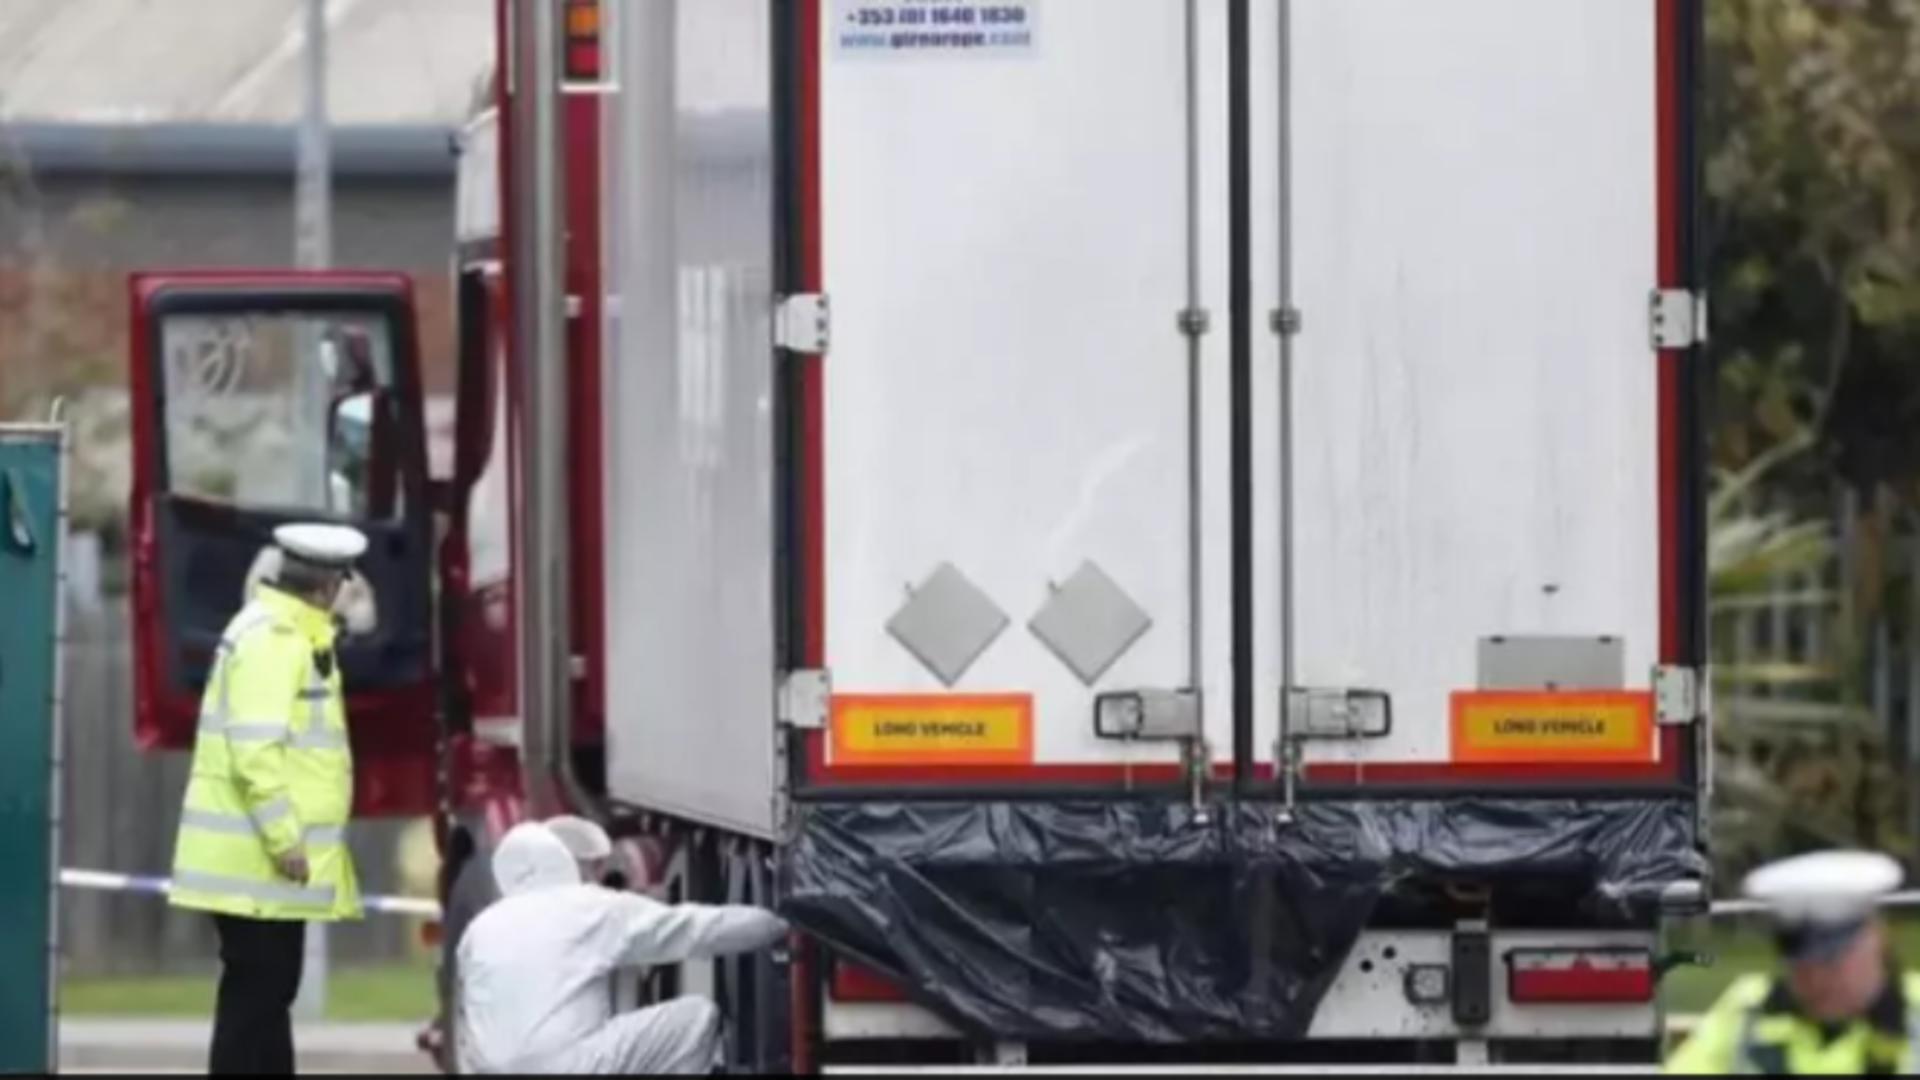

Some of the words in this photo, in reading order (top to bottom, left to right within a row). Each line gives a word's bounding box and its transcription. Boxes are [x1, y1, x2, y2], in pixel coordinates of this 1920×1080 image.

[874, 721, 916, 736] LONG
[920, 721, 984, 736] VEHICLE
[1493, 719, 1537, 735] LONG
[1542, 719, 1606, 735] VEHICLE
